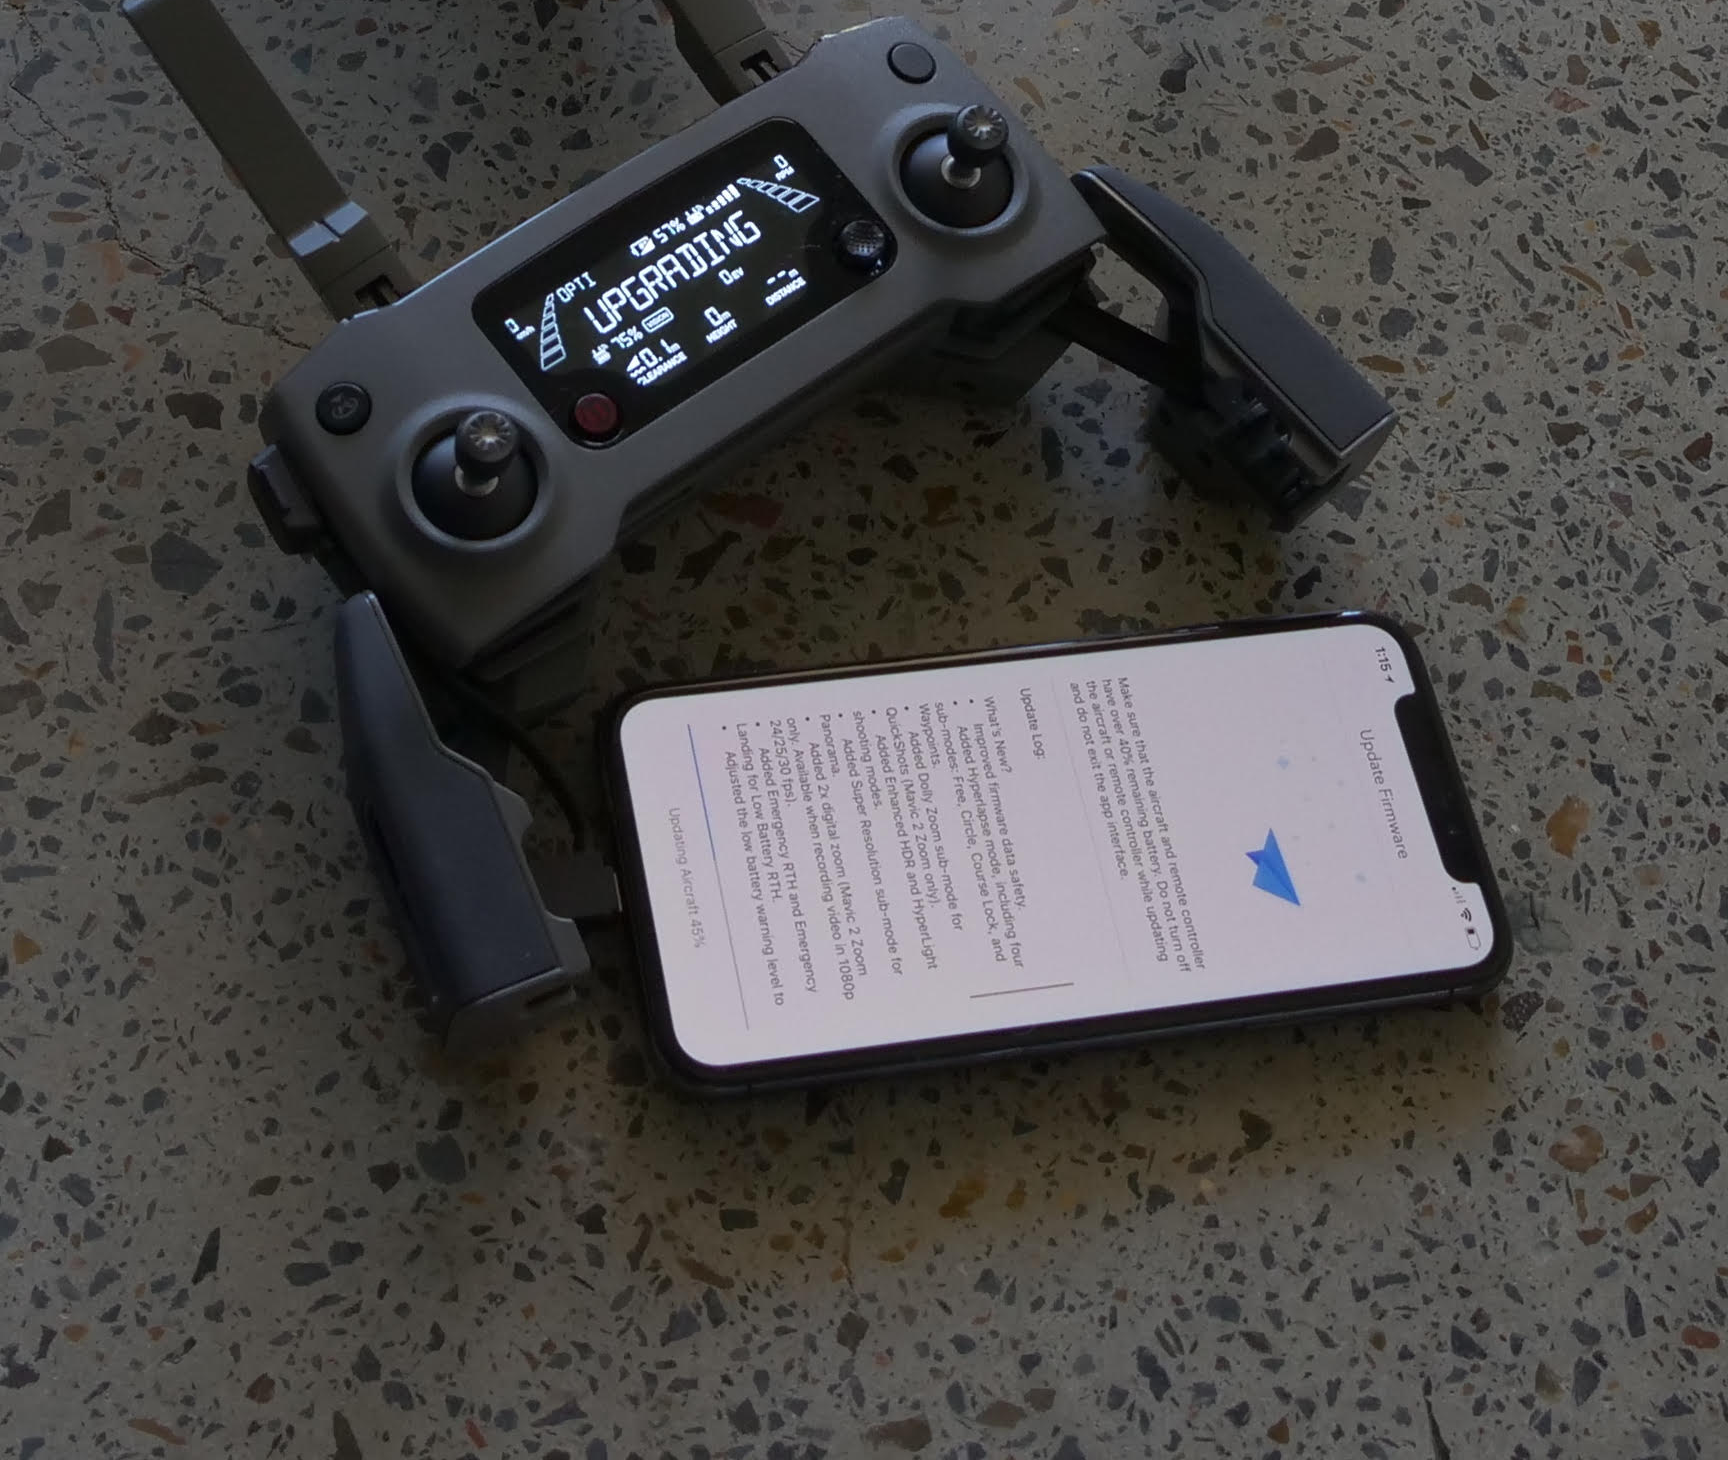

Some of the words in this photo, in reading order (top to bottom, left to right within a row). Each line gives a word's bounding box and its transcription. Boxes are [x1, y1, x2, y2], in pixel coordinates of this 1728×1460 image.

[773, 154, 789, 169] 0
[652, 217, 686, 244] 57%
[556, 272, 596, 303] OPTI
[583, 209, 761, 334] UPGRADING
[765, 276, 807, 306] DISTANCE
[610, 325, 643, 349] 75%
[706, 318, 738, 344] HEIGHT
[636, 351, 688, 386] CLEARANCE
[1373, 646, 1392, 671] 1:15
[1069, 682, 1086, 704] and
[1085, 680, 1098, 700] the
[1101, 678, 1116, 706] have
[1117, 676, 1133, 709] Make
[786, 717, 800, 745] only.
[1019, 687, 1038, 731] Update
[1031, 733, 1046, 760] Log:
[1075, 707, 1089, 723] do
[1091, 702, 1112, 745] aircraft
[1109, 709, 1125, 735] over
[1126, 711, 1141, 737] sure
[735, 722, 754, 772] Landing
[769, 719, 792, 776] 24/25/30
[818, 713, 841, 778] Panorama.
[885, 706, 909, 776] QuickShots
[907, 731, 928, 770] Added
[918, 702, 941, 769] Waypoints.
[973, 723, 997, 779] Improved
[1080, 725, 1095, 746] not
[1119, 738, 1135, 766] 40%
[1134, 739, 1150, 764] that
[757, 747, 777, 787] Added
[808, 741, 828, 781] Added
[841, 738, 861, 778] Added
[852, 710, 874, 763] shooting
[864, 765, 883, 810] modes.
[874, 734, 895, 774] Added
[993, 739, 1013, 773] New?
[1087, 747, 1102, 770] exit
[1103, 747, 1115, 760] or
[724, 751, 747, 805] Adjusted
[746, 773, 759, 792] for
[780, 777, 798, 807] fps).
[792, 748, 813, 802] Available
[817, 784, 830, 799] 2x
[917, 772, 933, 804] Dolly
[1093, 772, 1106, 792] the
[1107, 762, 1127, 806] remote
[1141, 766, 1155, 787] the
[750, 794, 765, 820] Low
[850, 780, 868, 817] Super
[884, 776, 909, 837] Enhanced
[899, 778, 921, 819] (Mavic
[987, 781, 1008, 836] firmware
[1098, 795, 1113, 819] app
[1125, 768, 1149, 828] remaining
[1147, 789, 1169, 833] aircraft
[1359, 728, 1385, 785] Update
[1378, 788, 1408, 859] Firmware
[736, 807, 749, 828] the
[766, 789, 789, 859] Emergency
[805, 805, 820, 839] when
[821, 802, 840, 840] digital
[911, 821, 925, 831] 2
[925, 806, 942, 843] Zoom
[934, 701, 959, 773] sub-modes:
[952, 775, 966, 807] Free,
[960, 809, 978, 849] Circle,
[970, 852, 990, 897] Course
[981, 899, 999, 935] Lock,
[991, 938, 1008, 962] and
[740, 830, 753, 853] low
[756, 822, 774, 868] Battery
[859, 819, 882, 885] Resolution
[898, 839, 916, 869] HDR
[912, 833, 931, 870] Zoom
[956, 725, 976, 765] Added
[967, 766, 991, 837] Hyperlapse
[984, 839, 1002, 878] mode,
[994, 881, 1017, 940] including
[1009, 941, 1024, 968] four
[1001, 837, 1016, 866] data
[1106, 821, 1129, 880] interface.
[1119, 808, 1144, 867] controller
[1142, 829, 1162, 877] battery.
[1160, 836, 1178, 859] and
[667, 807, 688, 865] Updating
[679, 868, 700, 915] Aircraft
[690, 918, 705, 948] 45%
[745, 855, 763, 901] battery
[782, 862, 798, 890] RTH
[812, 841, 834, 903] recording
[830, 843, 846, 878] zoom
[934, 845, 959, 910] sub-mode
[766, 871, 783, 903] RTH.
[905, 871, 922, 896] and
[923, 872, 941, 908] only).
[1008, 868, 1026, 911] safety.
[1137, 869, 1154, 903] while
[1155, 880, 1169, 899] Do
[1167, 862, 1187, 906] remote
[788, 892, 805, 917] and
[836, 881, 856, 923] (Mavic
[1161, 900, 1177, 923] not
[755, 903, 774, 956] warning
[826, 905, 842, 941] video
[848, 926, 861, 935] 2
[874, 888, 899, 954] sub-mode
[911, 897, 938, 970] HyperLight
[950, 912, 963, 931] for
[1145, 905, 1168, 962] updating
[1168, 924, 1183, 952] turn
[793, 920, 817, 993] Emergency
[834, 943, 847, 956] in
[1180, 909, 1205, 969] controller
[766, 958, 784, 989] level
[850, 939, 868, 976] Zoom
[890, 957, 903, 975] for
[1176, 954, 1192, 972] off
[838, 958, 855, 1000] 1080p
[773, 991, 784, 1006] to
